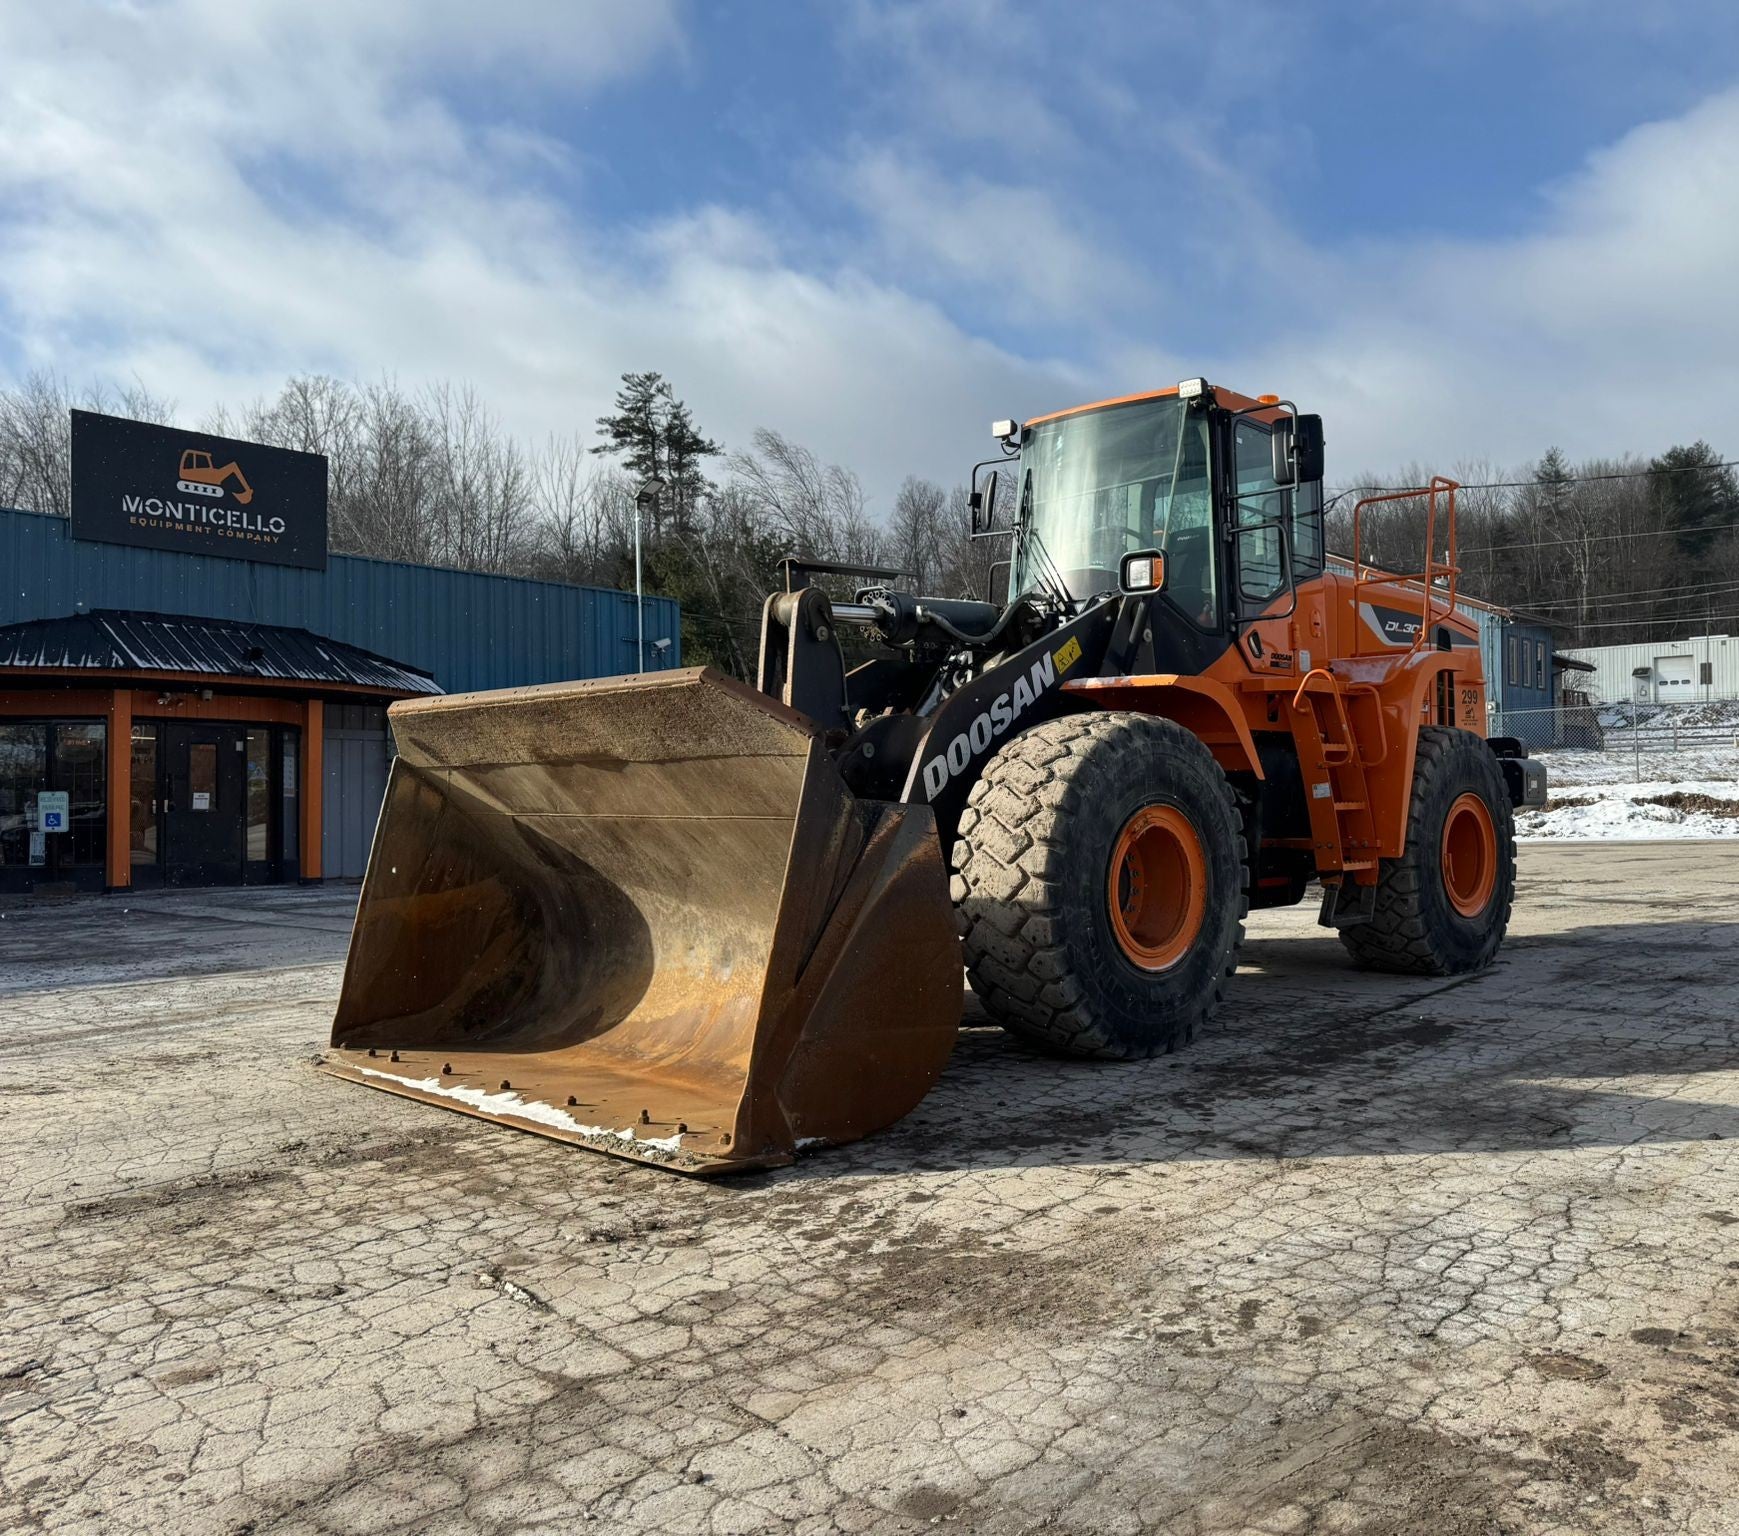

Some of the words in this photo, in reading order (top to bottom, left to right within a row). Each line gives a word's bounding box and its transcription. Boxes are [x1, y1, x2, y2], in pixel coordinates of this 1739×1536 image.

[123, 495, 285, 533] MONTICELLO
[130, 516, 211, 534] EQUIPMENT
[218, 529, 279, 543] COMPANY
[1461, 690, 1478, 704] 299
[923, 651, 1055, 802] DOOSAN
